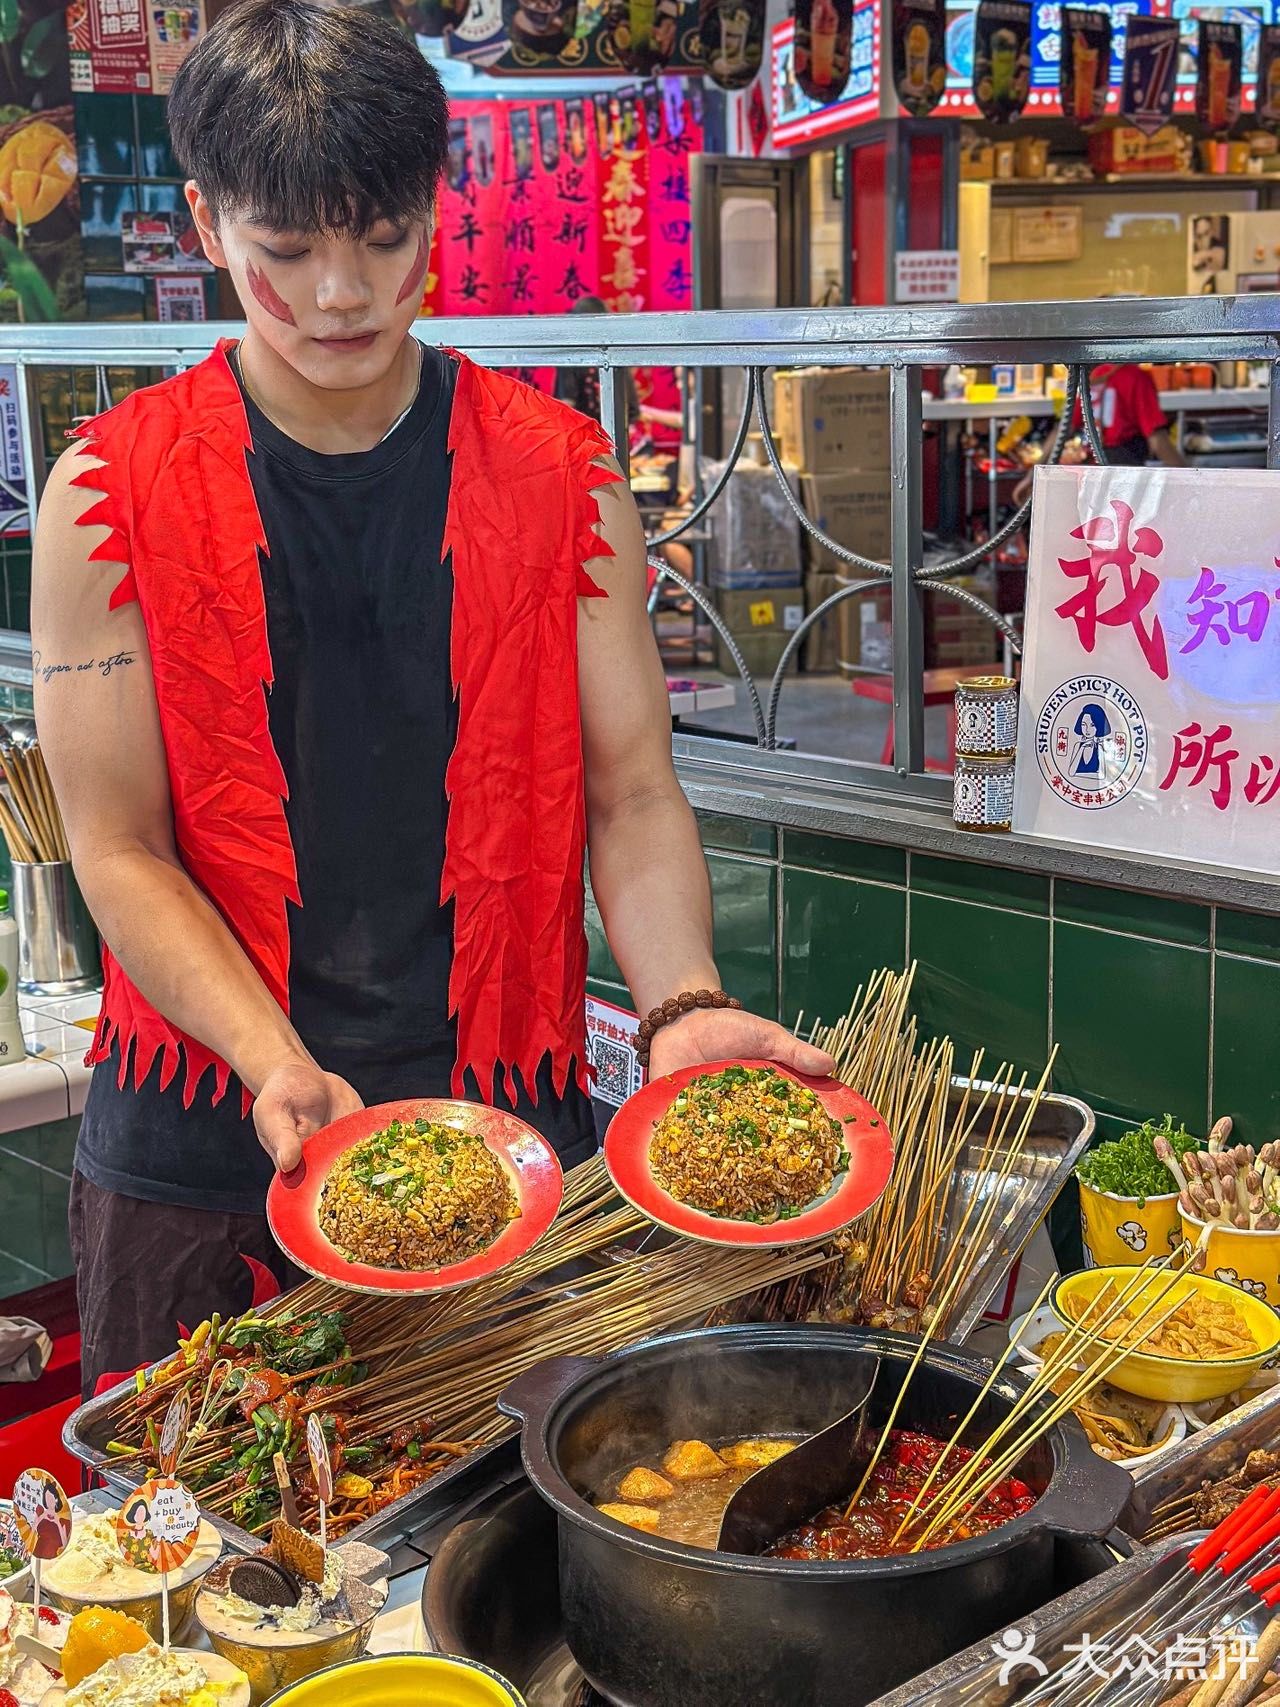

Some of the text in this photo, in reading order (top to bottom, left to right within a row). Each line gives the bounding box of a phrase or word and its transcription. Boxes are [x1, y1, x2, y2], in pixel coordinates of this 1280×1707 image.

[1055, 500, 1280, 681] 我知
[1038, 688, 1068, 753] SHUFEN
[1068, 679, 1111, 695] SPICY
[1112, 688, 1140, 722] HOT
[1132, 724, 1145, 763] POT
[157, 1495, 174, 1506] eat
[162, 1507, 182, 1516] buy
[165, 1521, 195, 1531] beauty
